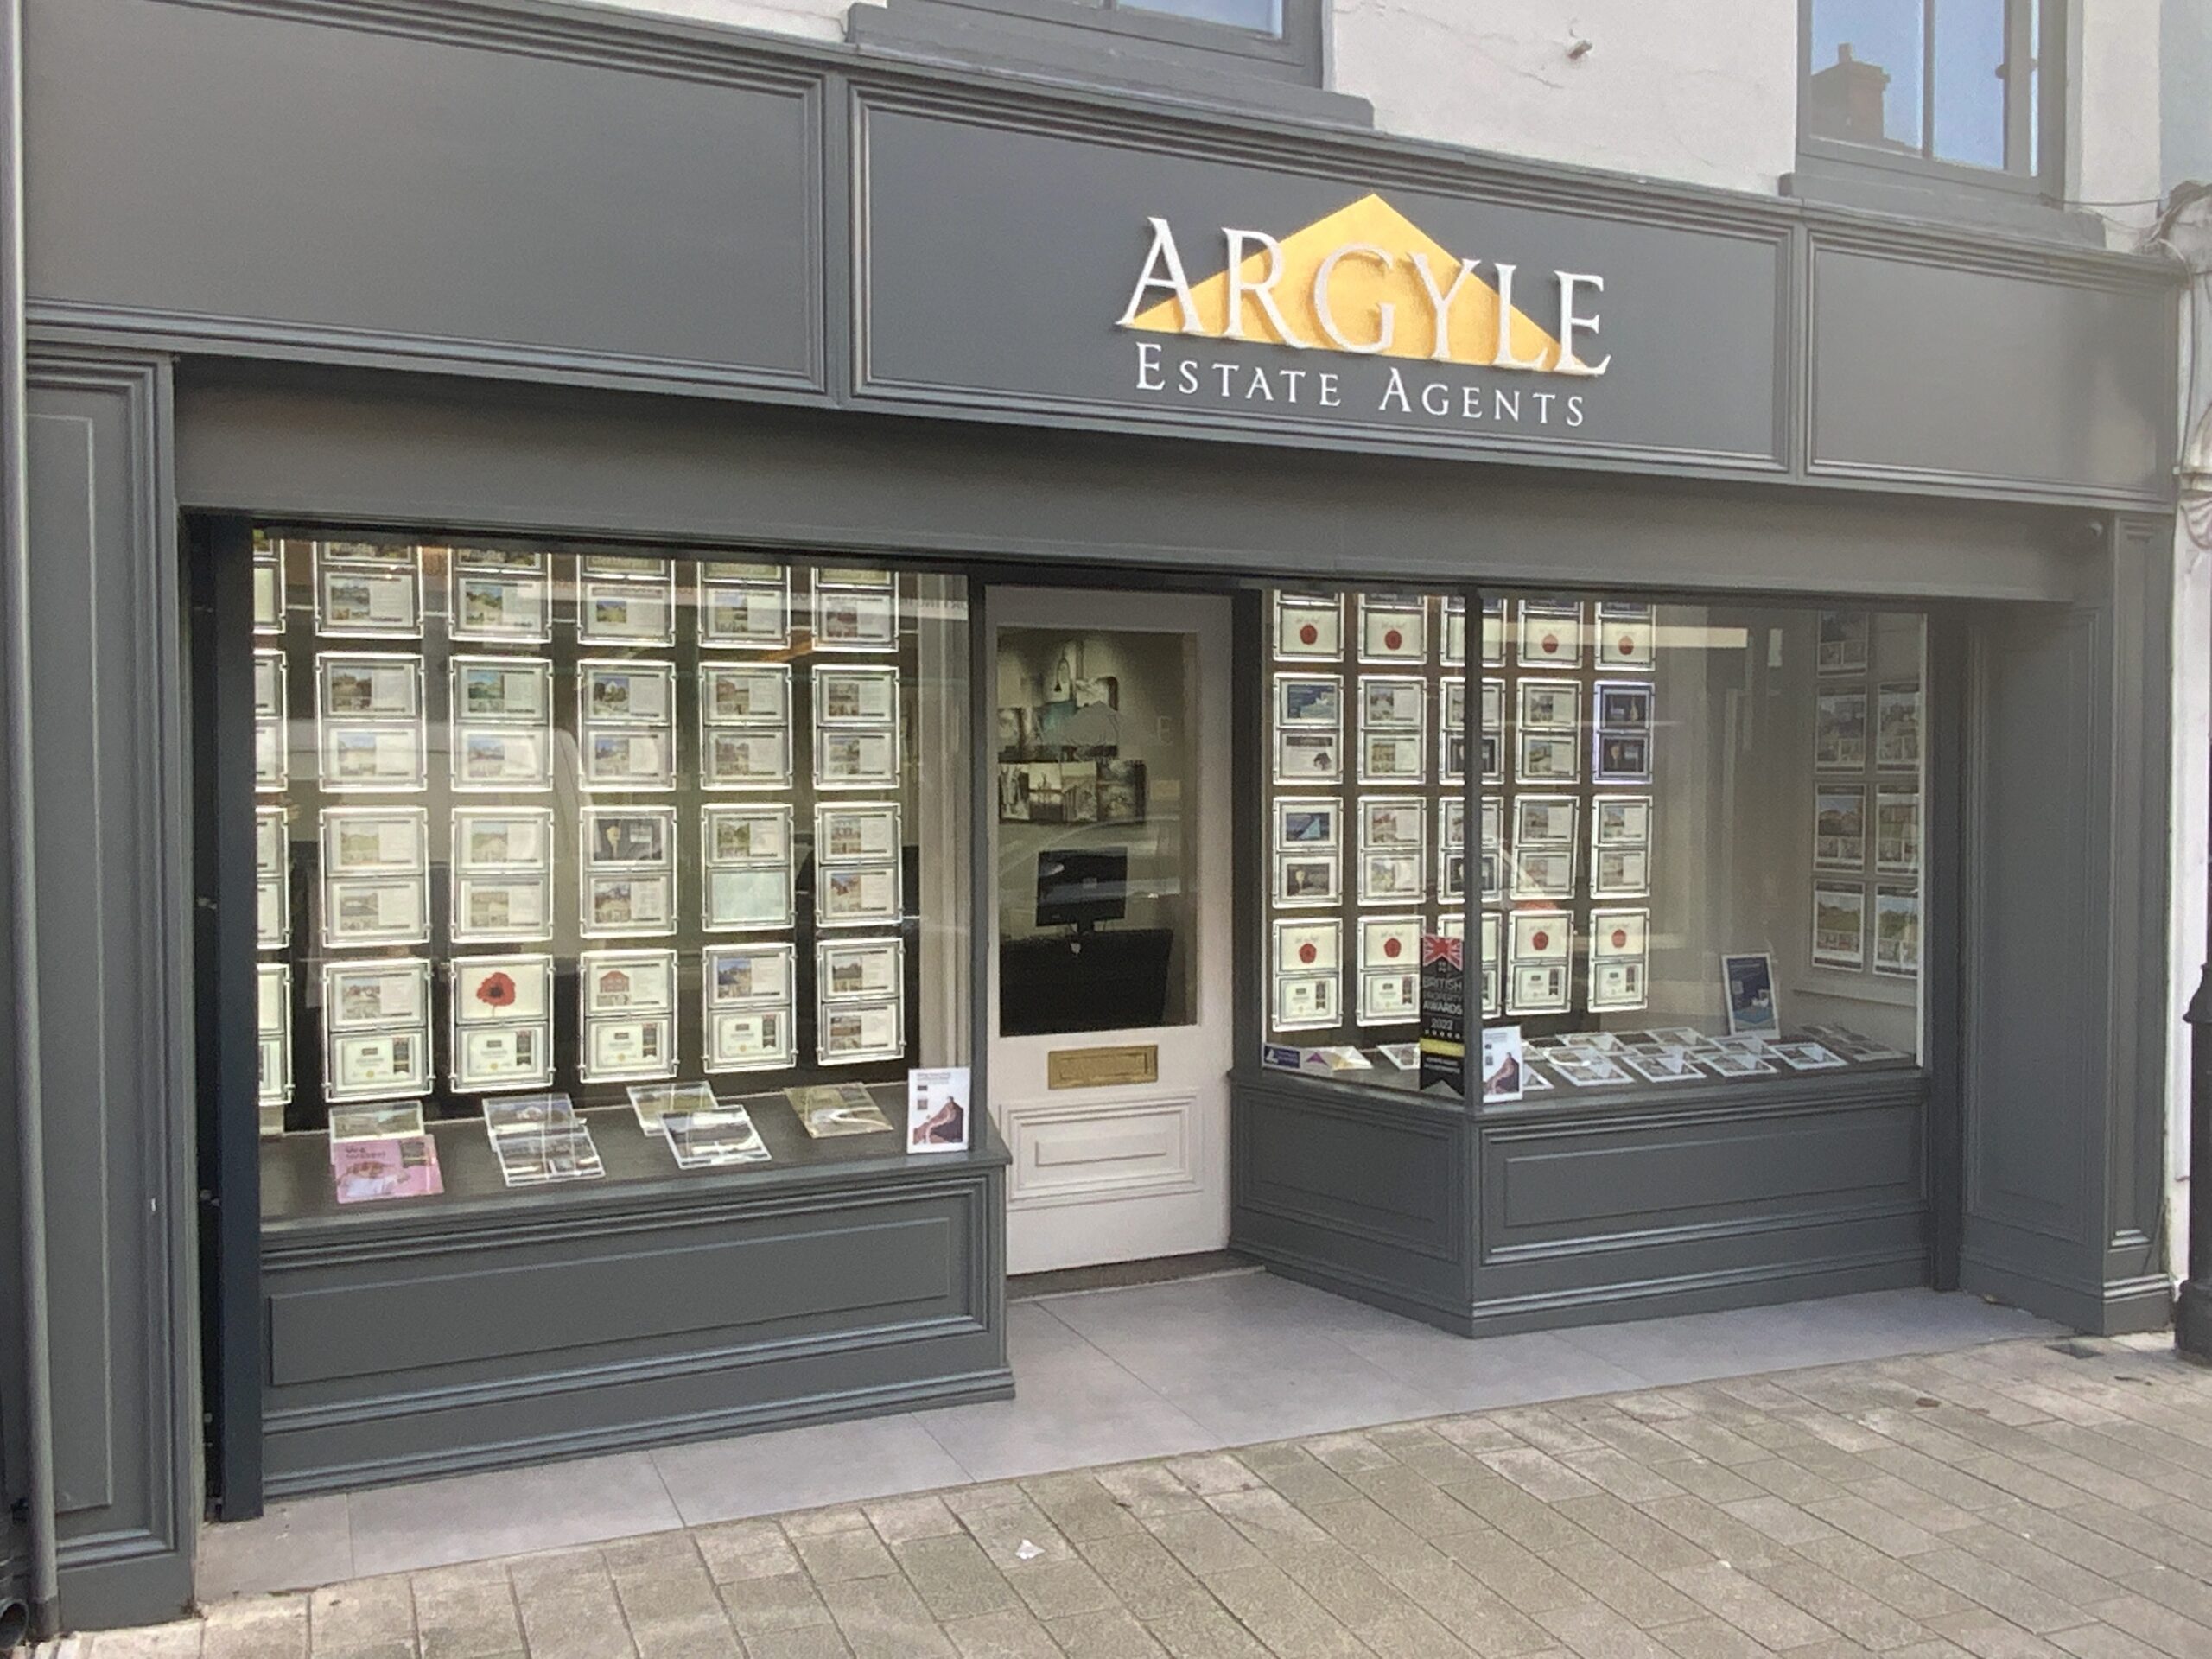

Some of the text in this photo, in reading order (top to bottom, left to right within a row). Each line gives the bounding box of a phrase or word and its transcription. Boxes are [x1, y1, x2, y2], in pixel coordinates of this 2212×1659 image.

[1116, 216, 1611, 376] ARGYLE
[1135, 342, 1584, 427] ESTATE AGENTS
[1423, 977, 1462, 991] BRITISH
[1423, 1001, 1462, 1014] AWARDS
